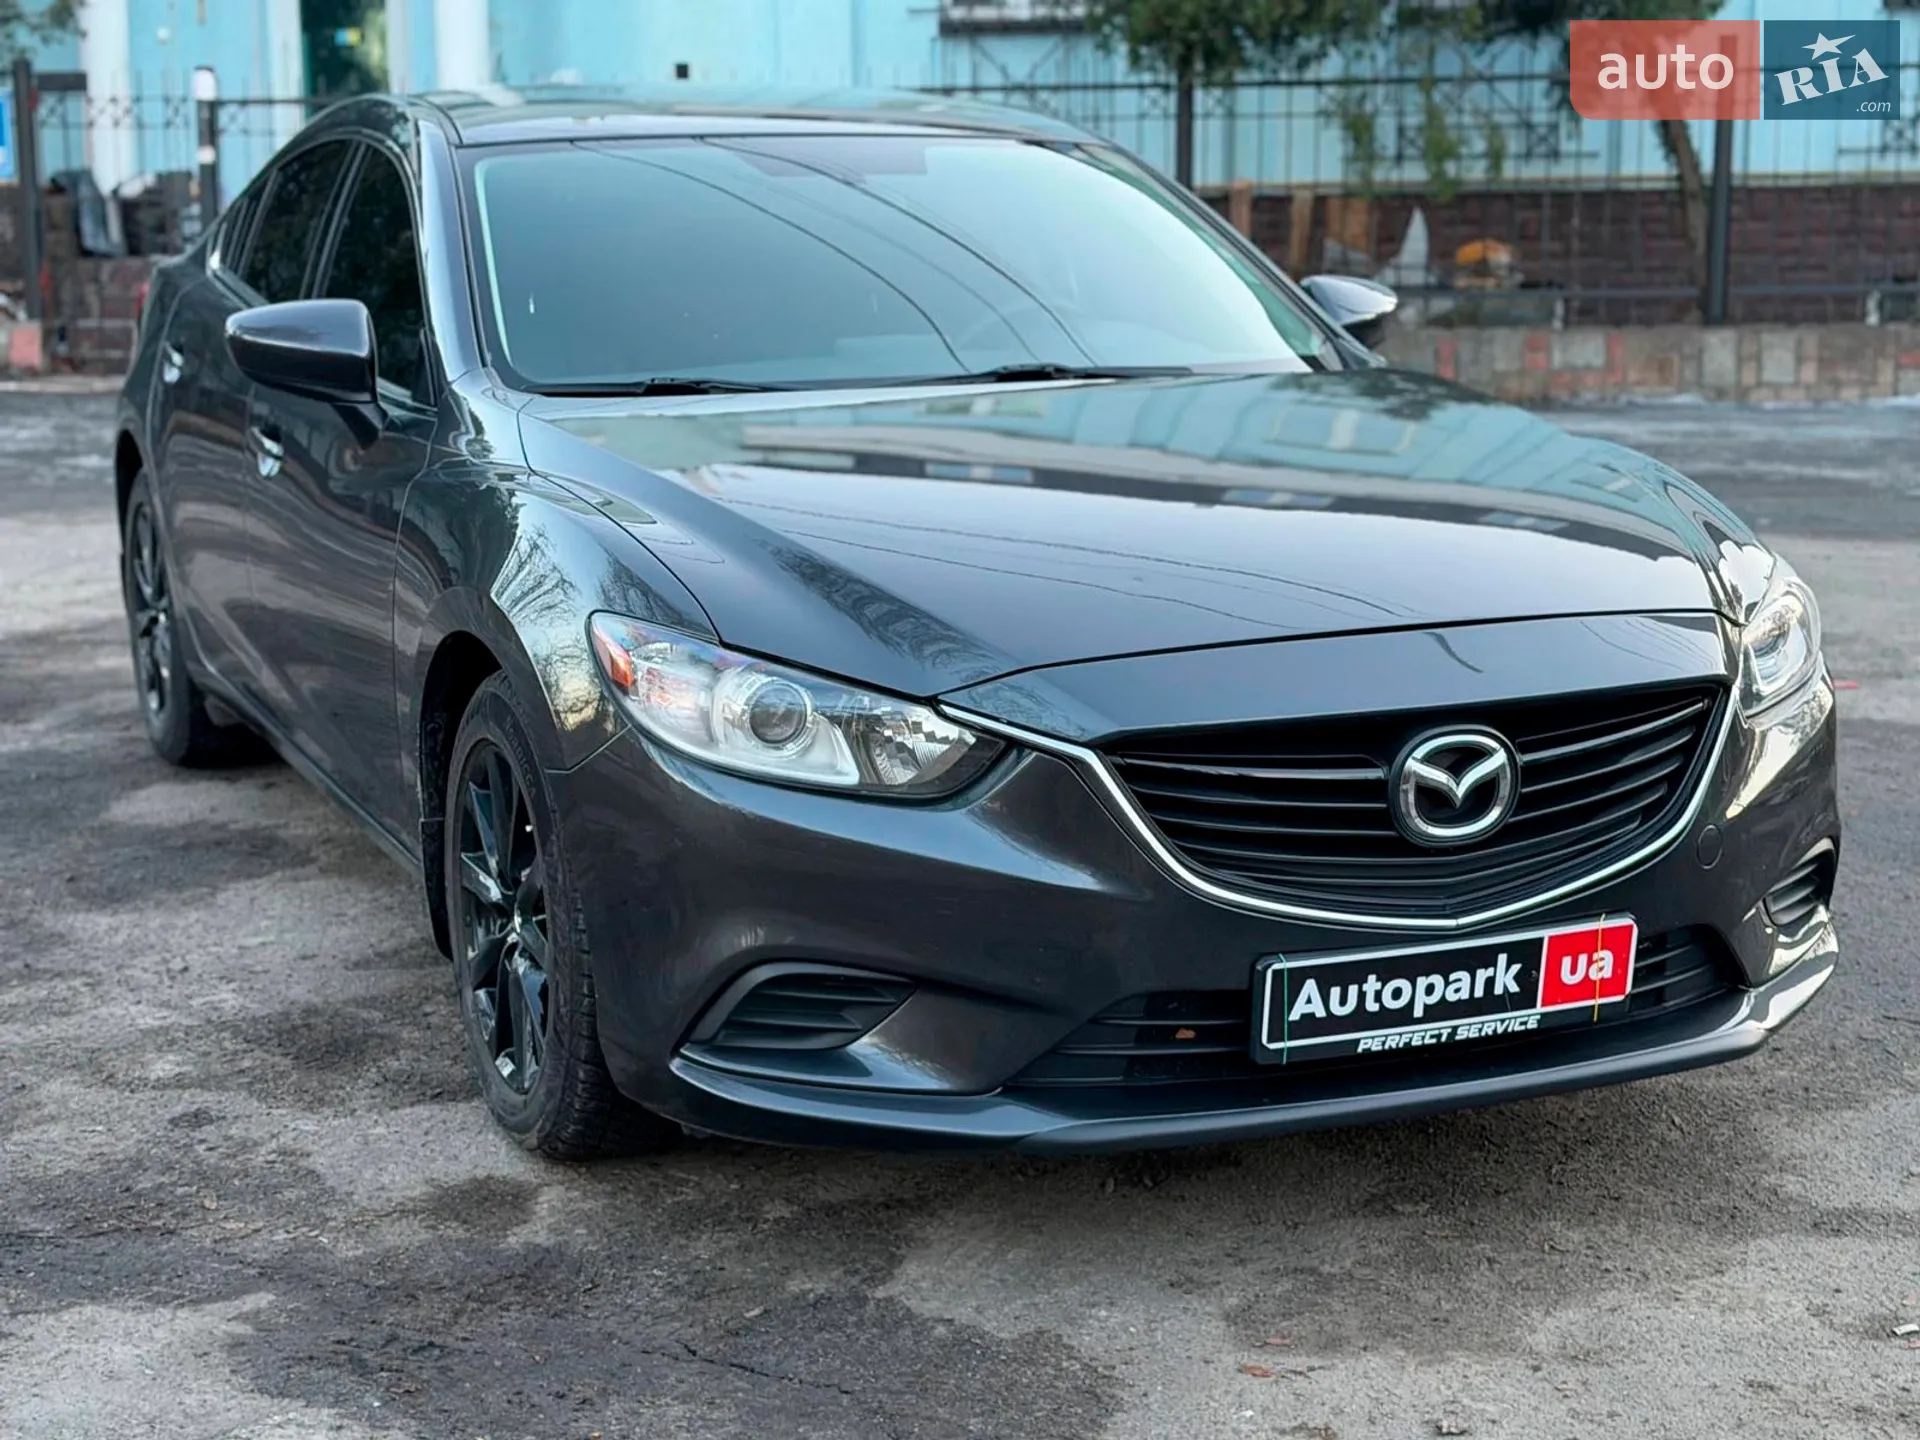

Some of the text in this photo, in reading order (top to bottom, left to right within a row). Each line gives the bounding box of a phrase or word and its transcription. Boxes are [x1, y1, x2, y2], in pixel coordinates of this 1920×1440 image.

[1288, 948, 1615, 1022] Autopark ua
[1356, 1014, 1542, 1054] PERFECT SERVICE
